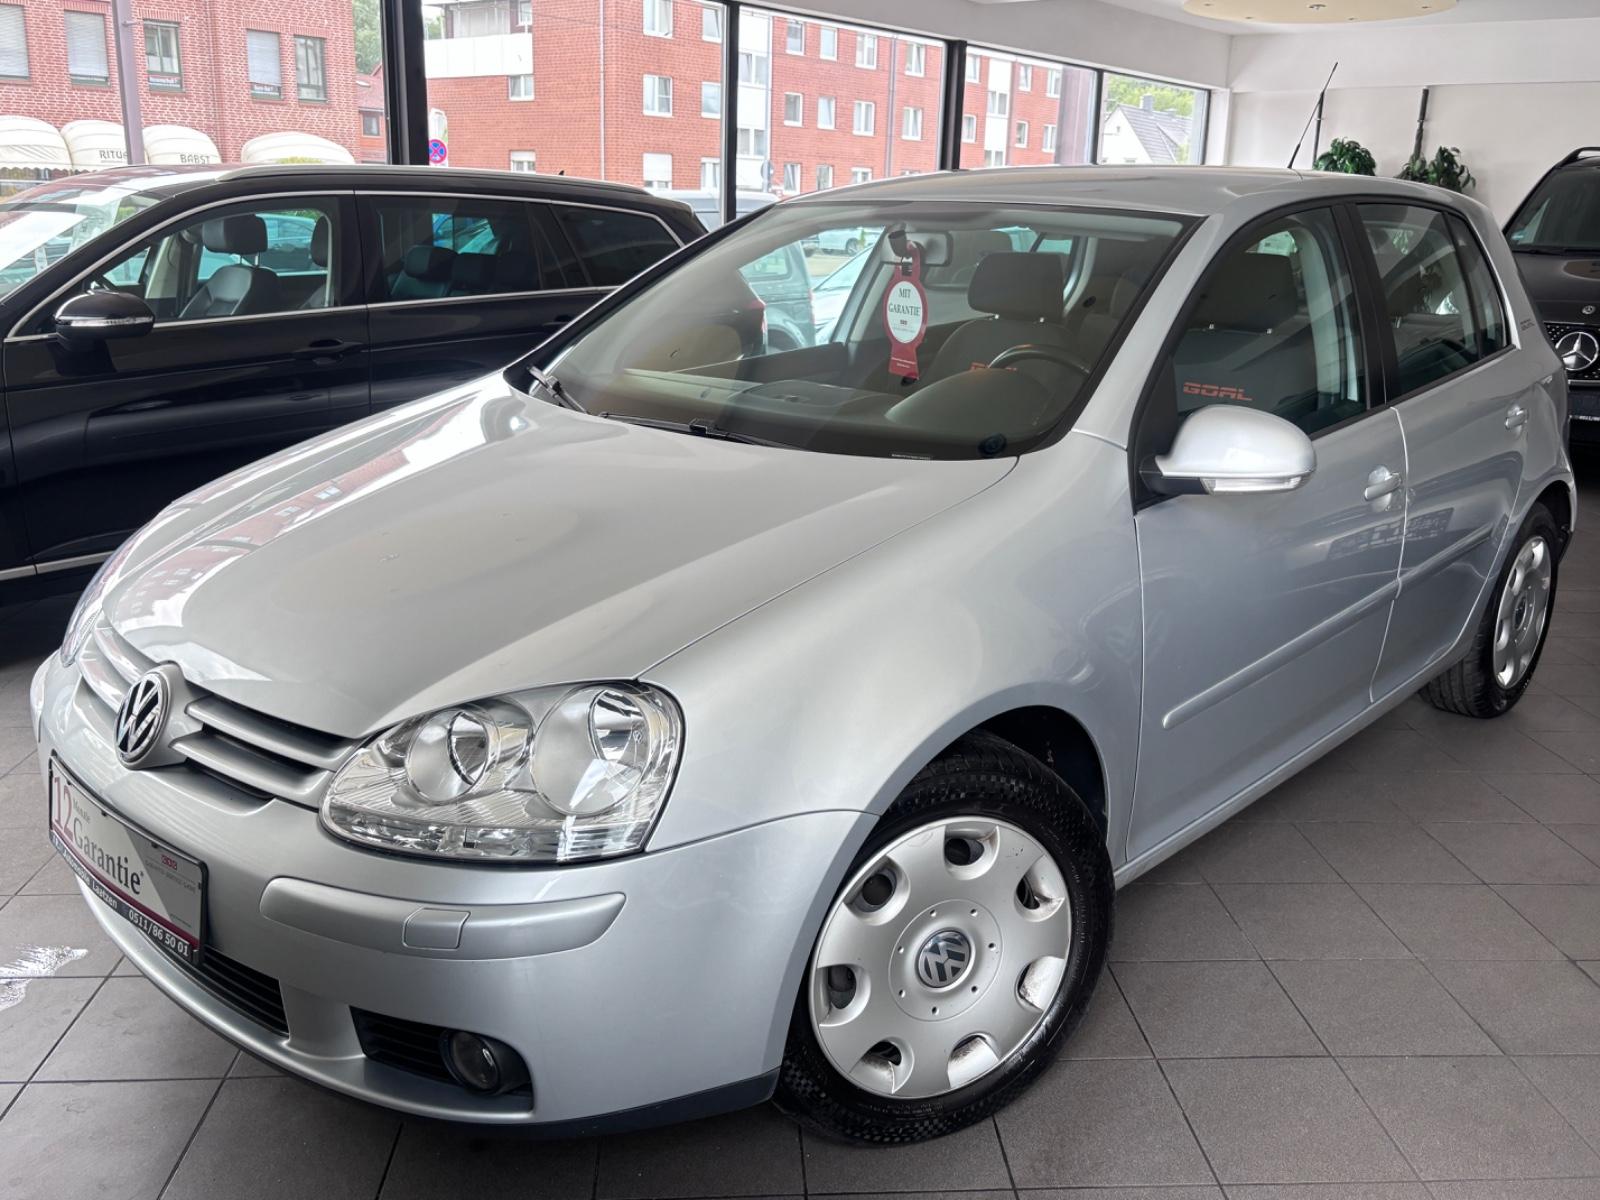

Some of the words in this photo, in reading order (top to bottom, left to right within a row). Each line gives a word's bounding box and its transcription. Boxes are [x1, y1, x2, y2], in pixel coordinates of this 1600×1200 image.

[898, 287, 911, 299] MIT
[888, 303, 921, 316] GARANTIE
[1183, 381, 1253, 401] GOAL
[53, 776, 75, 843] 12
[128, 909, 164, 940] 0511/86
[164, 933, 176, 948] 50
[177, 941, 189, 957] 01
